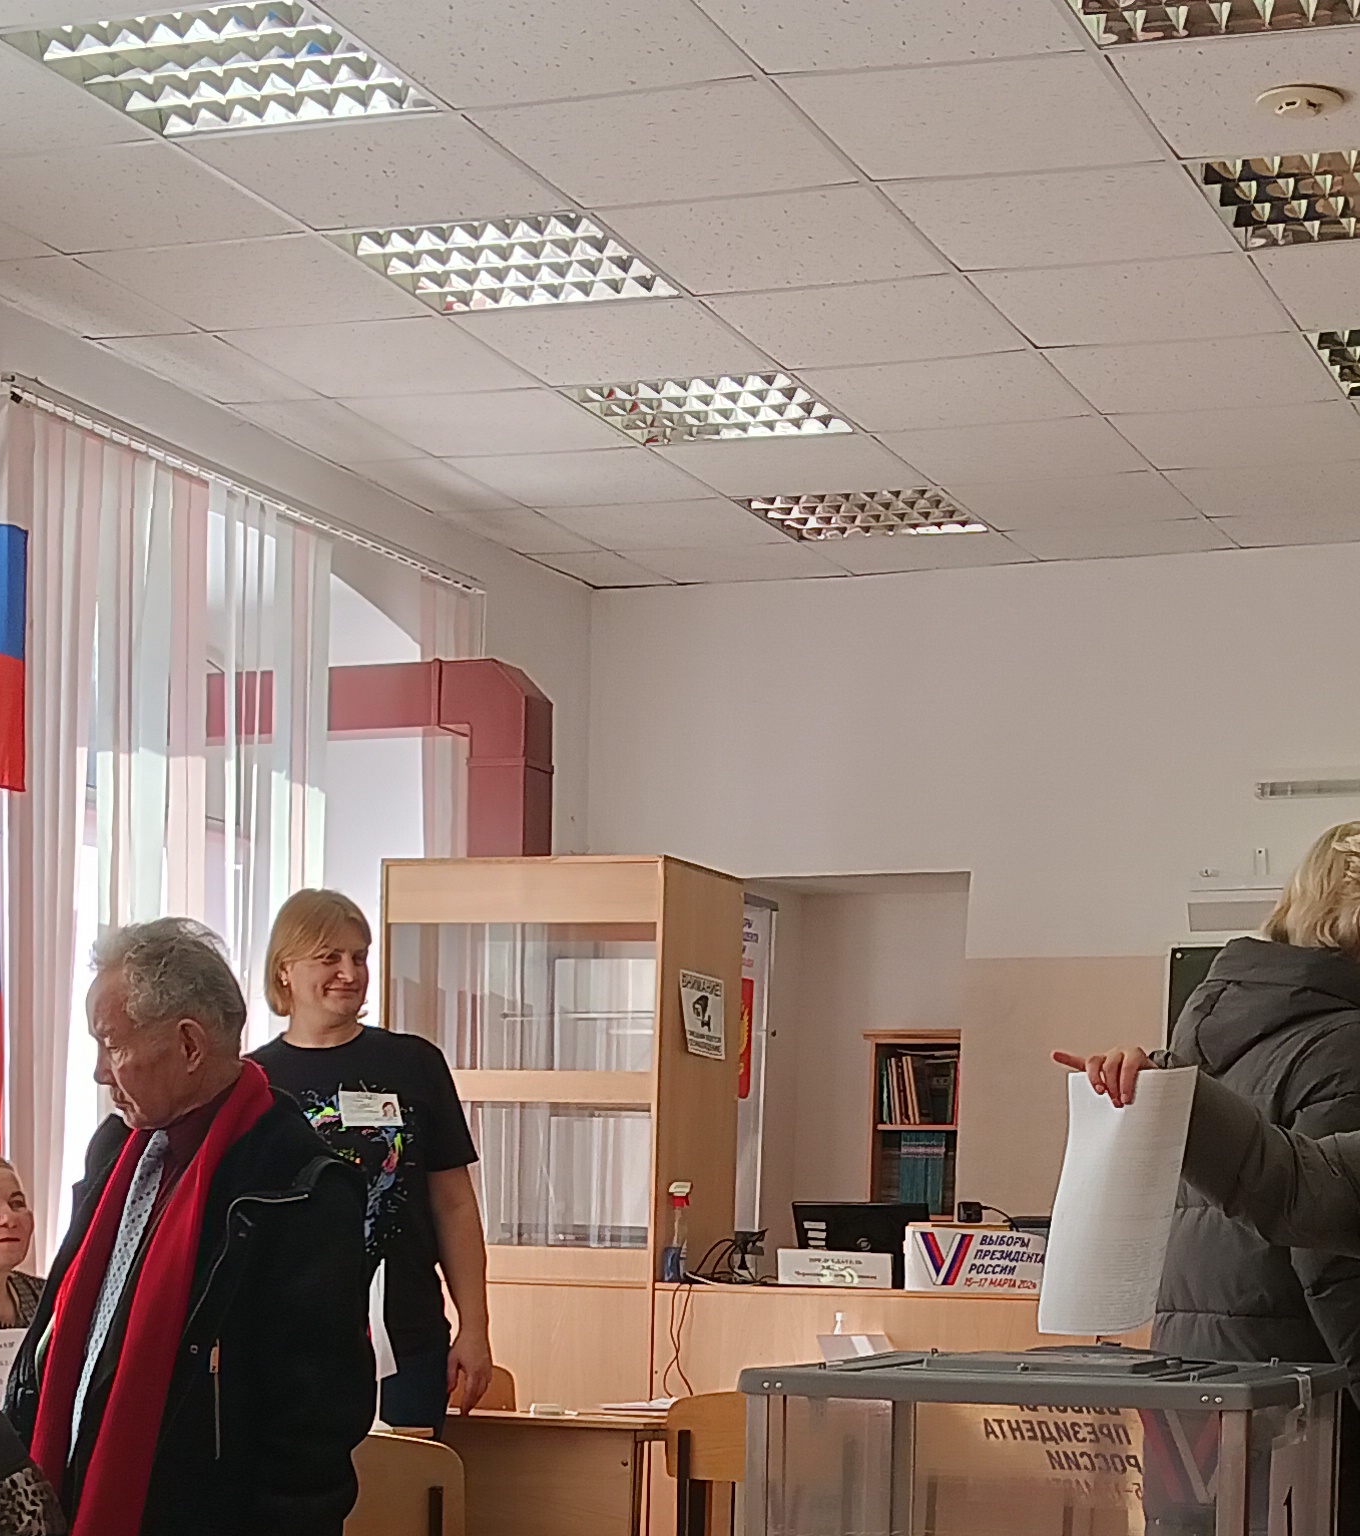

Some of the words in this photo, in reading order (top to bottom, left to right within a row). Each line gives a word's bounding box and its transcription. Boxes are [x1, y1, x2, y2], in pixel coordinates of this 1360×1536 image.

[980, 1235, 1031, 1249] ВЫБОРЫ
[974, 1249, 1045, 1265] ПРЕЗИДЕНТА
[968, 1263, 1017, 1276] РОССИИ
